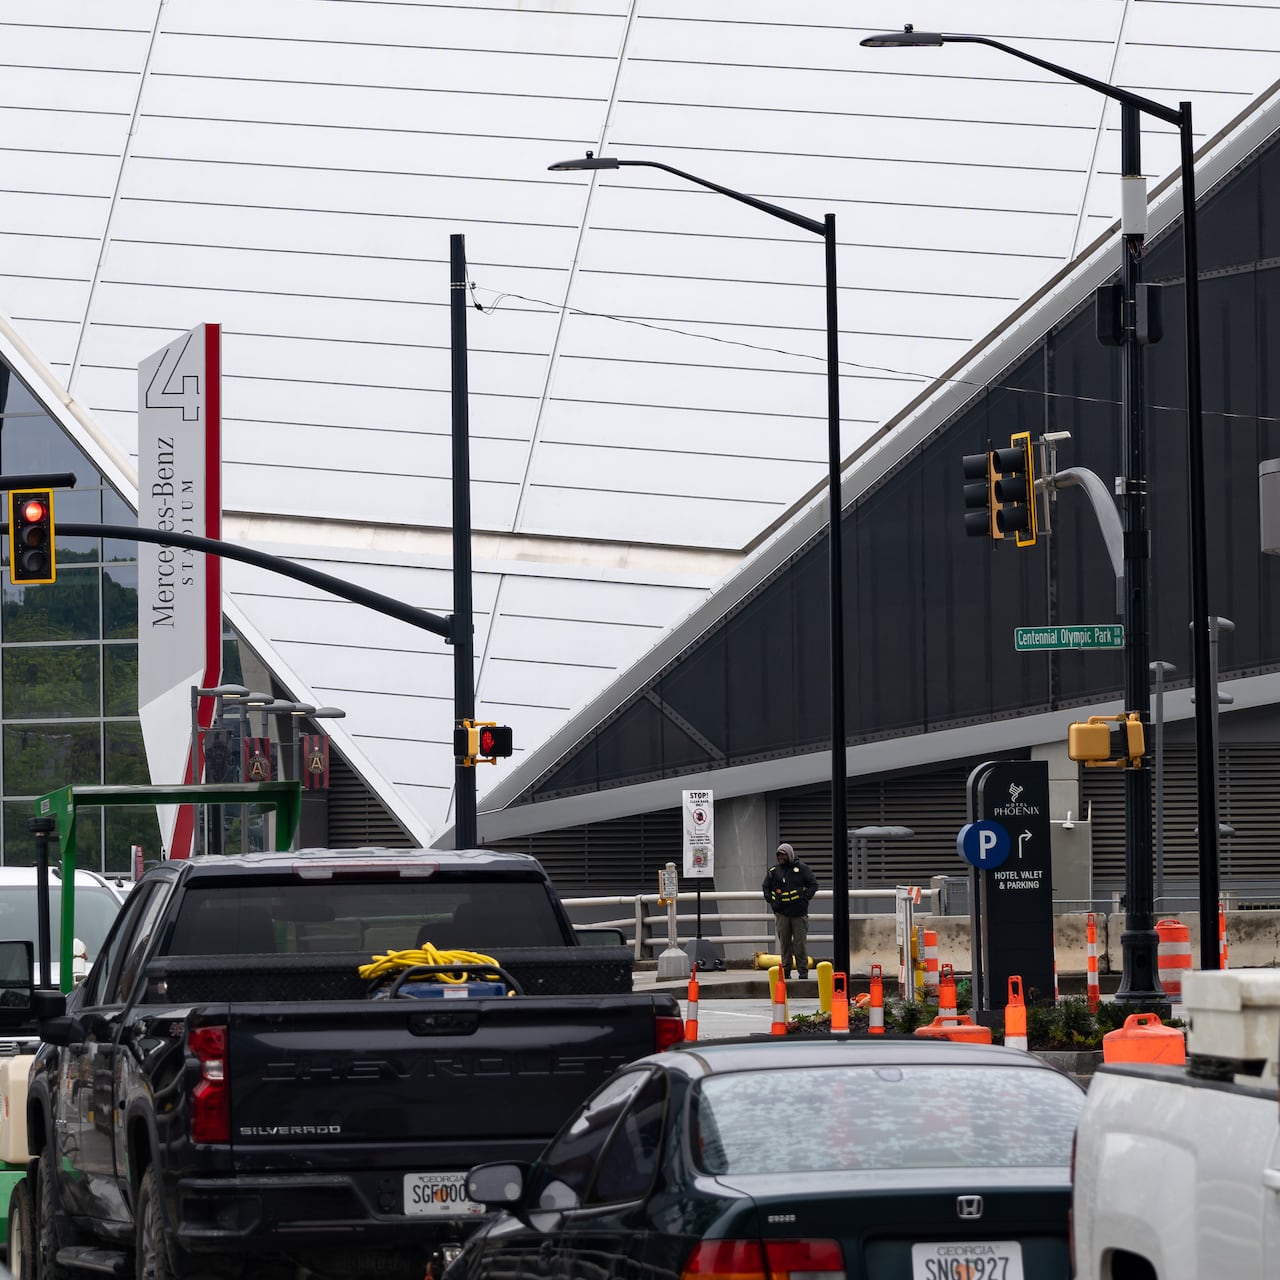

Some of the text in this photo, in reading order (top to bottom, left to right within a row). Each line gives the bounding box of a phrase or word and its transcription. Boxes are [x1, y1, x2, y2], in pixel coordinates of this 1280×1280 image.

[1018, 629, 1058, 646] Centennial
[1060, 628, 1092, 647] Olympic
[1094, 627, 1112, 644] Park
[993, 806, 1041, 816] PHOENIX
[979, 829, 998, 860] P
[994, 870, 1043, 880] HOTEL VALET
[998, 880, 1040, 890] & PARKING
[239, 1125, 341, 1136] SILVERADO
[412, 1183, 470, 1205] SGF000
[936, 1245, 996, 1257] GEORGIA
